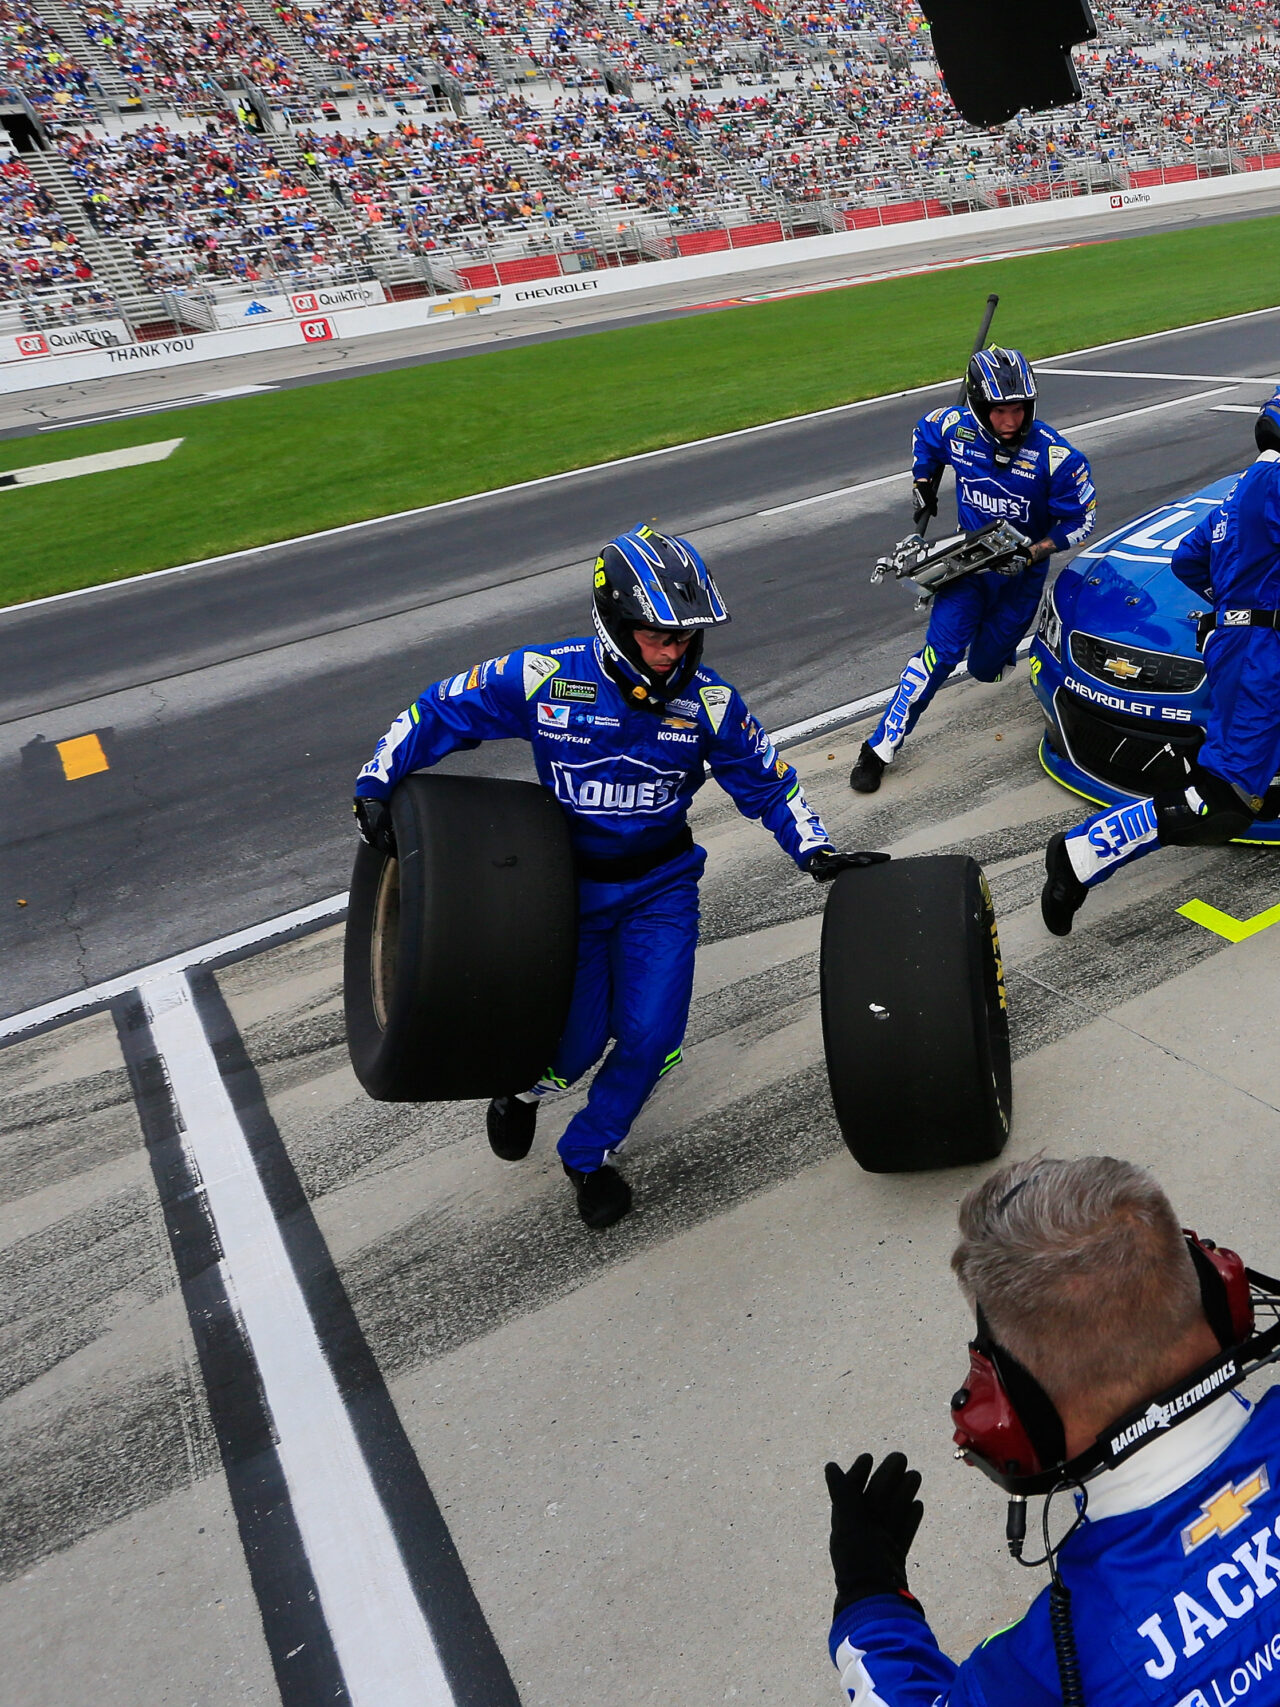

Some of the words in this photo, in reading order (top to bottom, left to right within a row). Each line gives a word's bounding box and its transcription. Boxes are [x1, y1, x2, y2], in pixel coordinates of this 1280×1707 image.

[1123, 193, 1151, 205] QuikTrip
[294, 295, 315, 311] QT
[319, 289, 371, 306] QuikTrip
[514, 280, 599, 301] CHEVROLET
[19, 336, 46, 353] QT
[50, 328, 112, 348] QuikTrip
[303, 322, 327, 339] QT
[107, 345, 160, 363] THANK
[163, 339, 195, 354] YOU
[1011, 467, 1037, 480] KOBALT
[961, 483, 1022, 516] LOWE'S
[595, 556, 606, 589] 48
[680, 616, 714, 627] KOBALT
[550, 644, 587, 656] KOBALT
[886, 664, 928, 743] LOWE'S
[1064, 675, 1156, 717] CHEVROLET
[1161, 707, 1193, 722] SS
[537, 729, 592, 745] GOODYEAR
[657, 731, 699, 744] KOBALT
[563, 771, 674, 809] LOWE'S
[1087, 800, 1158, 859] OWE'S
[1110, 1416, 1158, 1456] RACING
[1161, 1359, 1237, 1419] ELECTRONICS
